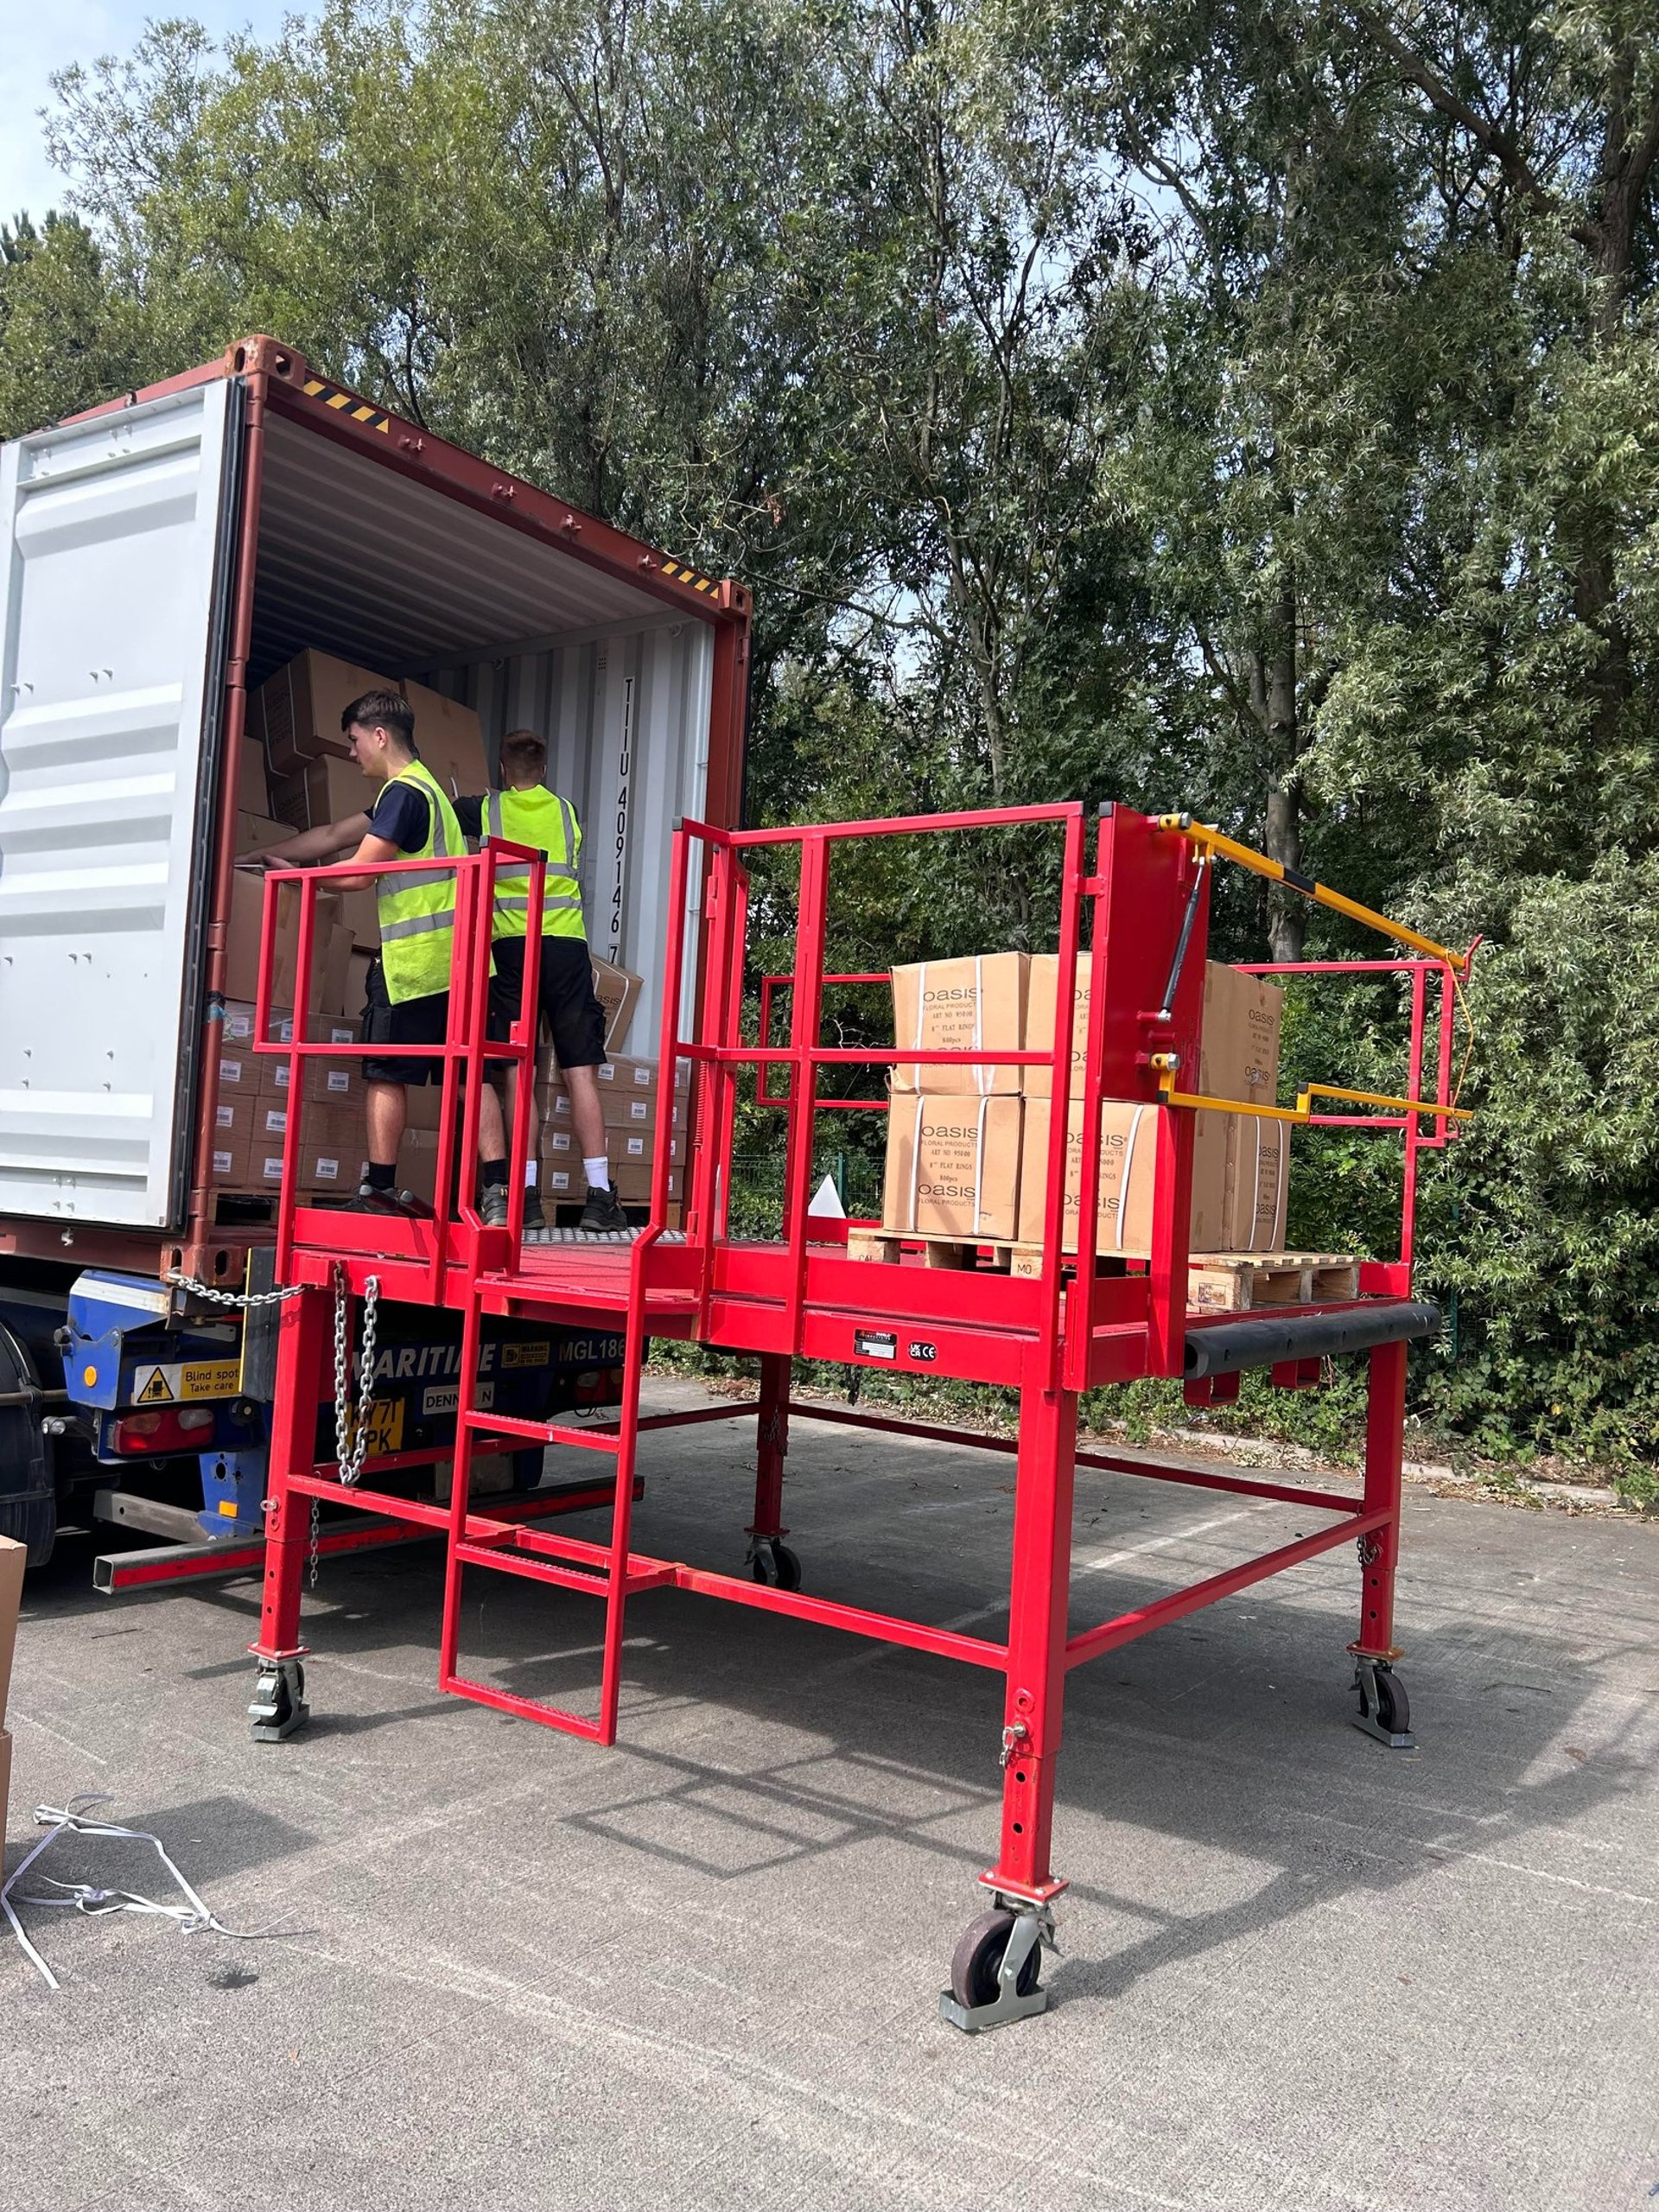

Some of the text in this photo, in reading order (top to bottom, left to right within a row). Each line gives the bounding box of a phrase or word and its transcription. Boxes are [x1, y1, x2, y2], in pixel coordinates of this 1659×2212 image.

[611, 785, 628, 934] 409146
[186, 1370, 239, 1382] Blind spot
[190, 1382, 234, 1393] Take care
